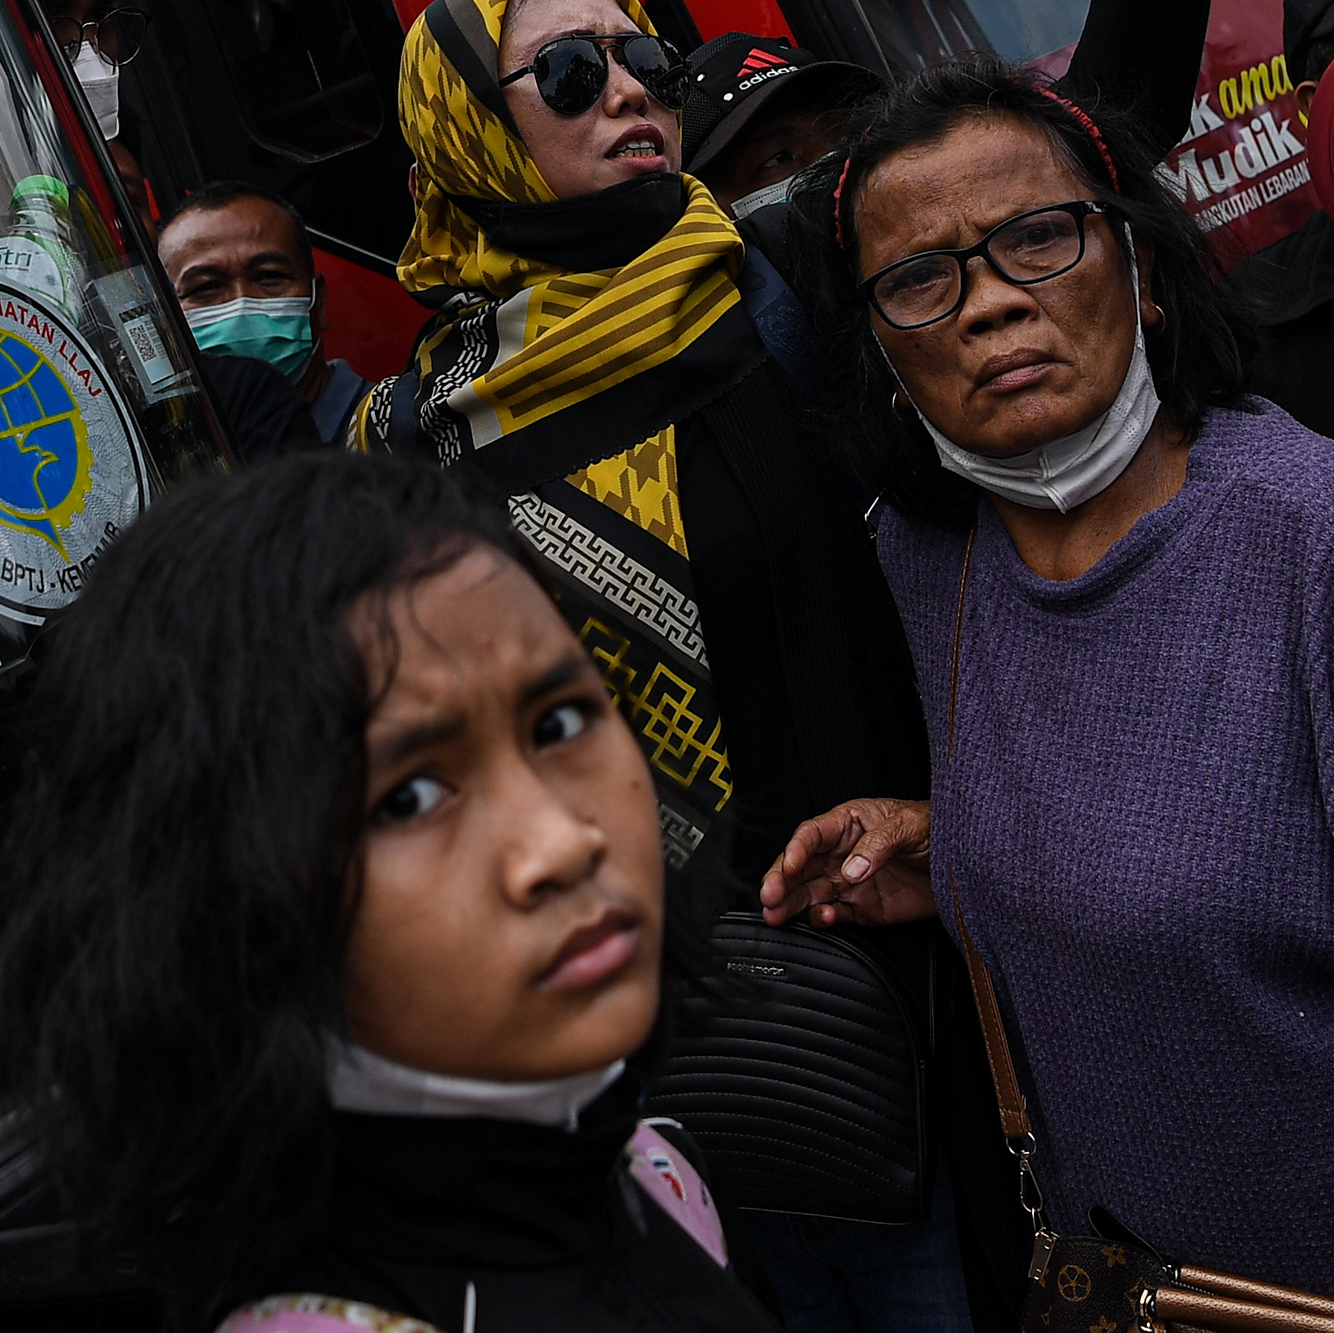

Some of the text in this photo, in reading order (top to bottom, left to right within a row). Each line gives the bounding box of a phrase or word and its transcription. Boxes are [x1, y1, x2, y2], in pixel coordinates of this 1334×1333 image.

[739, 65, 800, 92] adidas
[1152, 111, 1306, 204] Mudik
[58, 341, 103, 398] LLAJ
[1, 556, 46, 594] BPTJ
